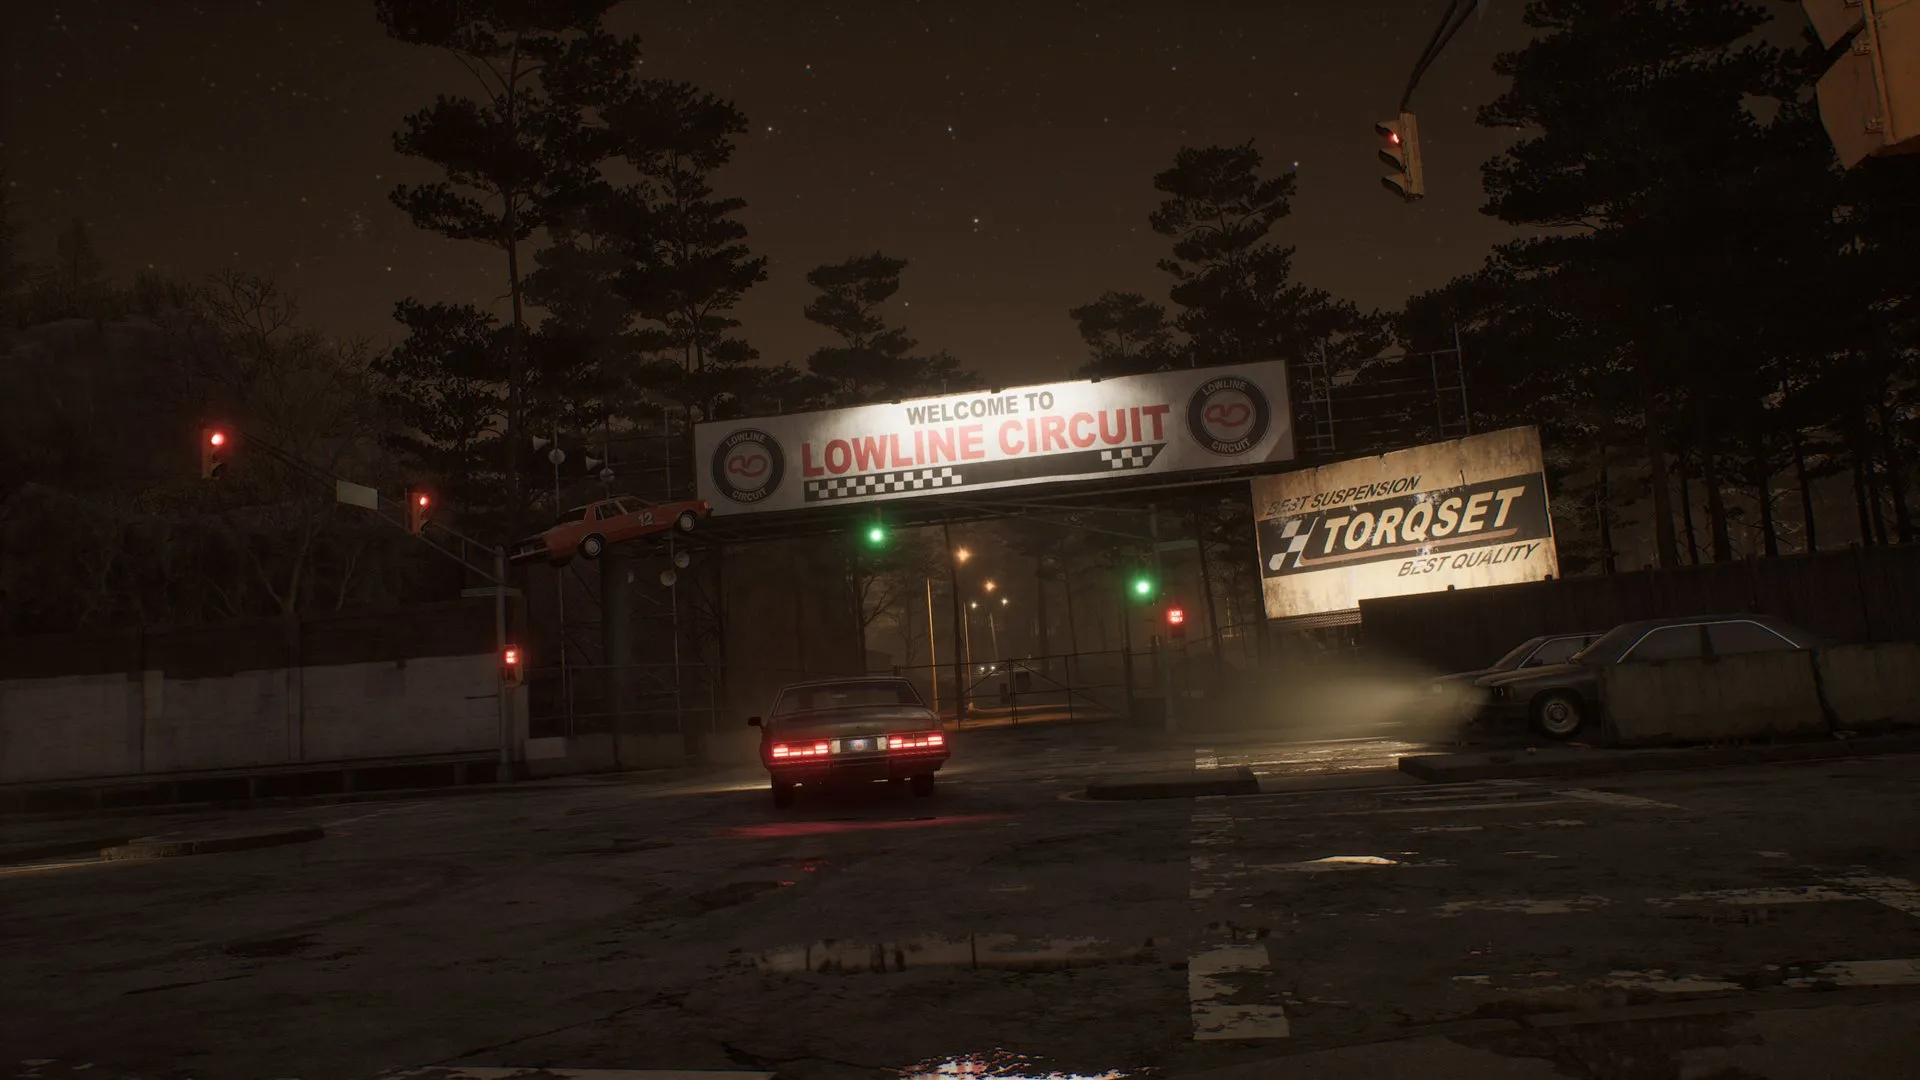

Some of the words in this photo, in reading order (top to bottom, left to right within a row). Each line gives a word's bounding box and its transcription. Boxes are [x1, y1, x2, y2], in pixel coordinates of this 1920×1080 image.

[1202, 379, 1247, 396] LOWLINE
[906, 394, 1018, 425] WELCOME
[1025, 391, 1054, 411] TO
[726, 431, 766, 447] LOWLINE
[801, 424, 985, 477] LOWLINE
[999, 404, 1170, 455] CIRCUIT
[1211, 438, 1250, 453] CIRCUIT
[732, 488, 767, 501] CIRCUIT
[1266, 495, 1311, 515] BEST
[1310, 475, 1421, 508] SUSPENSION
[638, 511, 653, 527] 12
[1322, 486, 1525, 554] TORQSET
[1398, 555, 1451, 577] BEST
[1452, 542, 1540, 569] QUALITY
